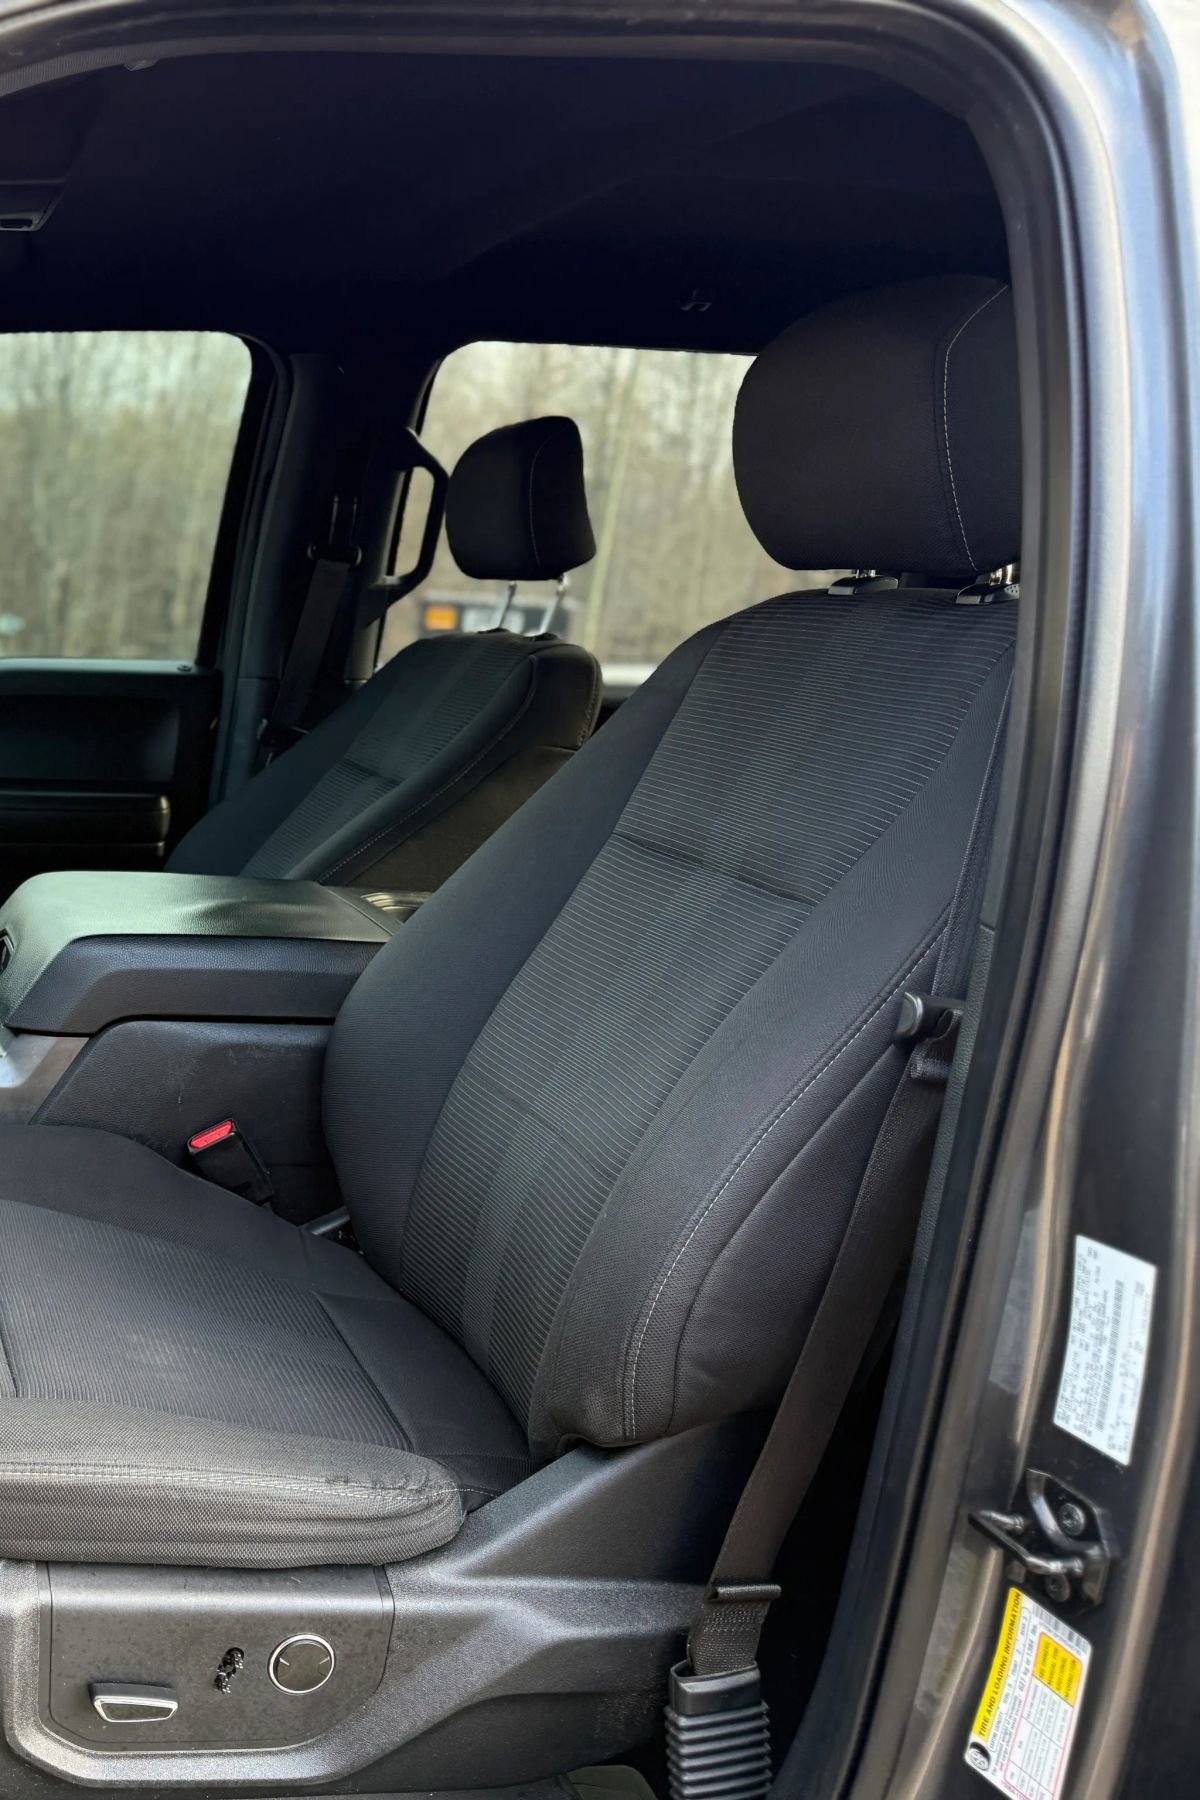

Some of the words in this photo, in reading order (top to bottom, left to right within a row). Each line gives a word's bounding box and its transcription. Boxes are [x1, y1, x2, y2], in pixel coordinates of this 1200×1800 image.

[978, 1715, 989, 1737] TIRE
[985, 1694, 996, 1714] AND
[991, 1654, 1008, 1694] LOADING
[1003, 1591, 1020, 1654] INFORMATION
